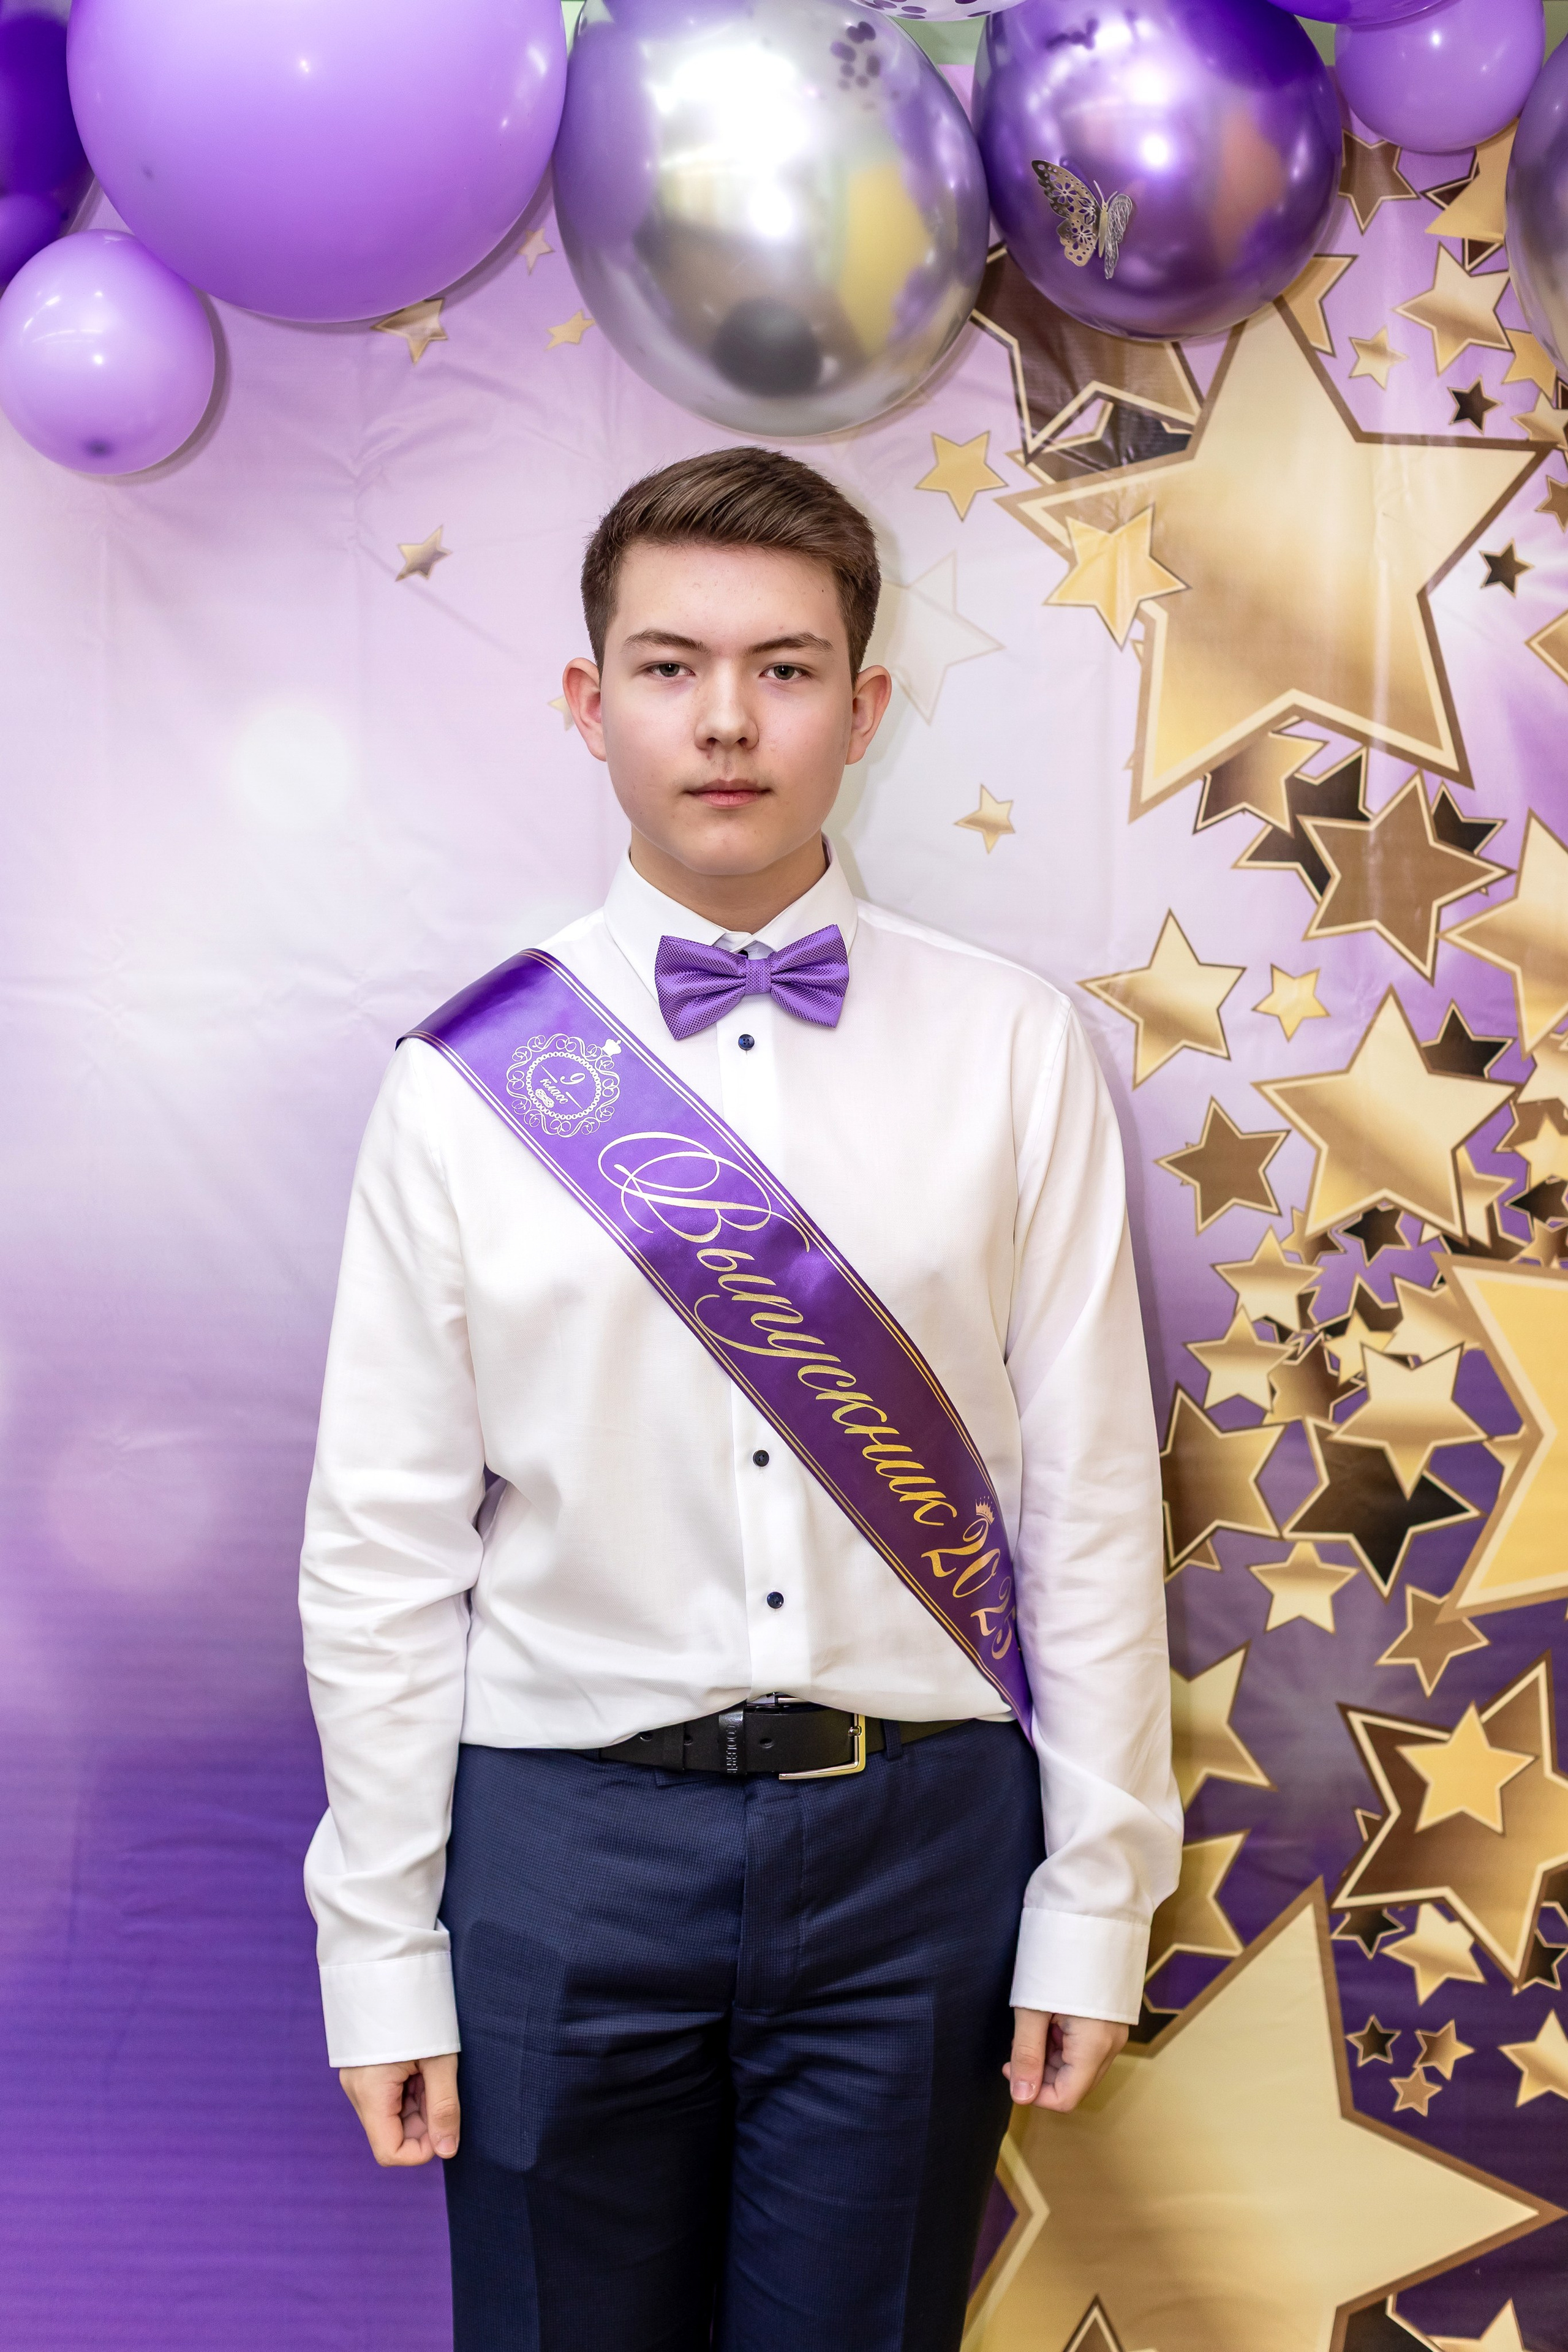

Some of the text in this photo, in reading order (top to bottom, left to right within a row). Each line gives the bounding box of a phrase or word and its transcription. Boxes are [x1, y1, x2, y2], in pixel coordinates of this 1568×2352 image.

[540, 1078, 568, 1104] класс
[559, 1072, 586, 1085] 9
[598, 1131, 957, 1526] Выпускник
